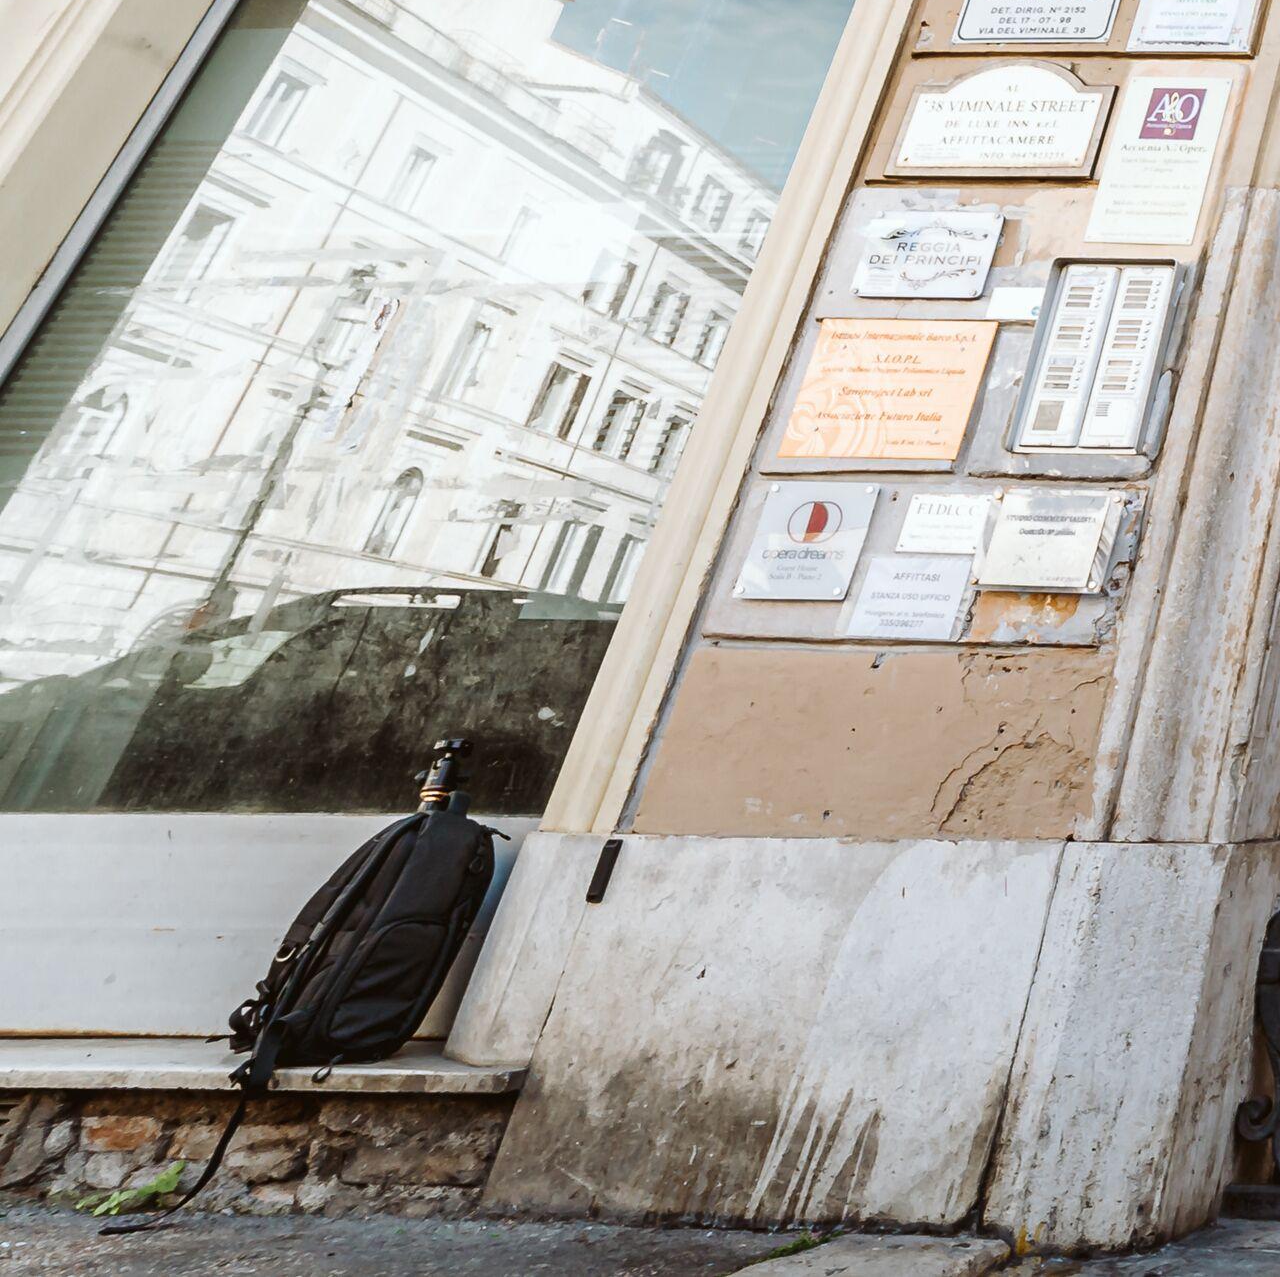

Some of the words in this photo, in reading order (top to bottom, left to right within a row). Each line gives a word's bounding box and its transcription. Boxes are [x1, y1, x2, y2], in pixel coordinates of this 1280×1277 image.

[1015, 6, 1045, 14] DIRIG.
[1064, 6, 1086, 14] 2152
[948, 99, 1025, 113] VIMINALE
[943, 119, 961, 129] DE
[967, 119, 1000, 129] LUXE
[1006, 119, 1029, 129] INN
[940, 135, 1056, 145] AFFITTACAMERE
[896, 242, 962, 253] REGGIA
[869, 254, 899, 265] DEI
[903, 254, 982, 266] PRINCIPI
[897, 386, 916, 397] Lab
[879, 411, 913, 421] Futuro
[915, 411, 943, 422] Italia
[892, 572, 941, 583] AFFITTASI
[870, 592, 900, 601] STANZA
[920, 593, 951, 602] UFFICIO
